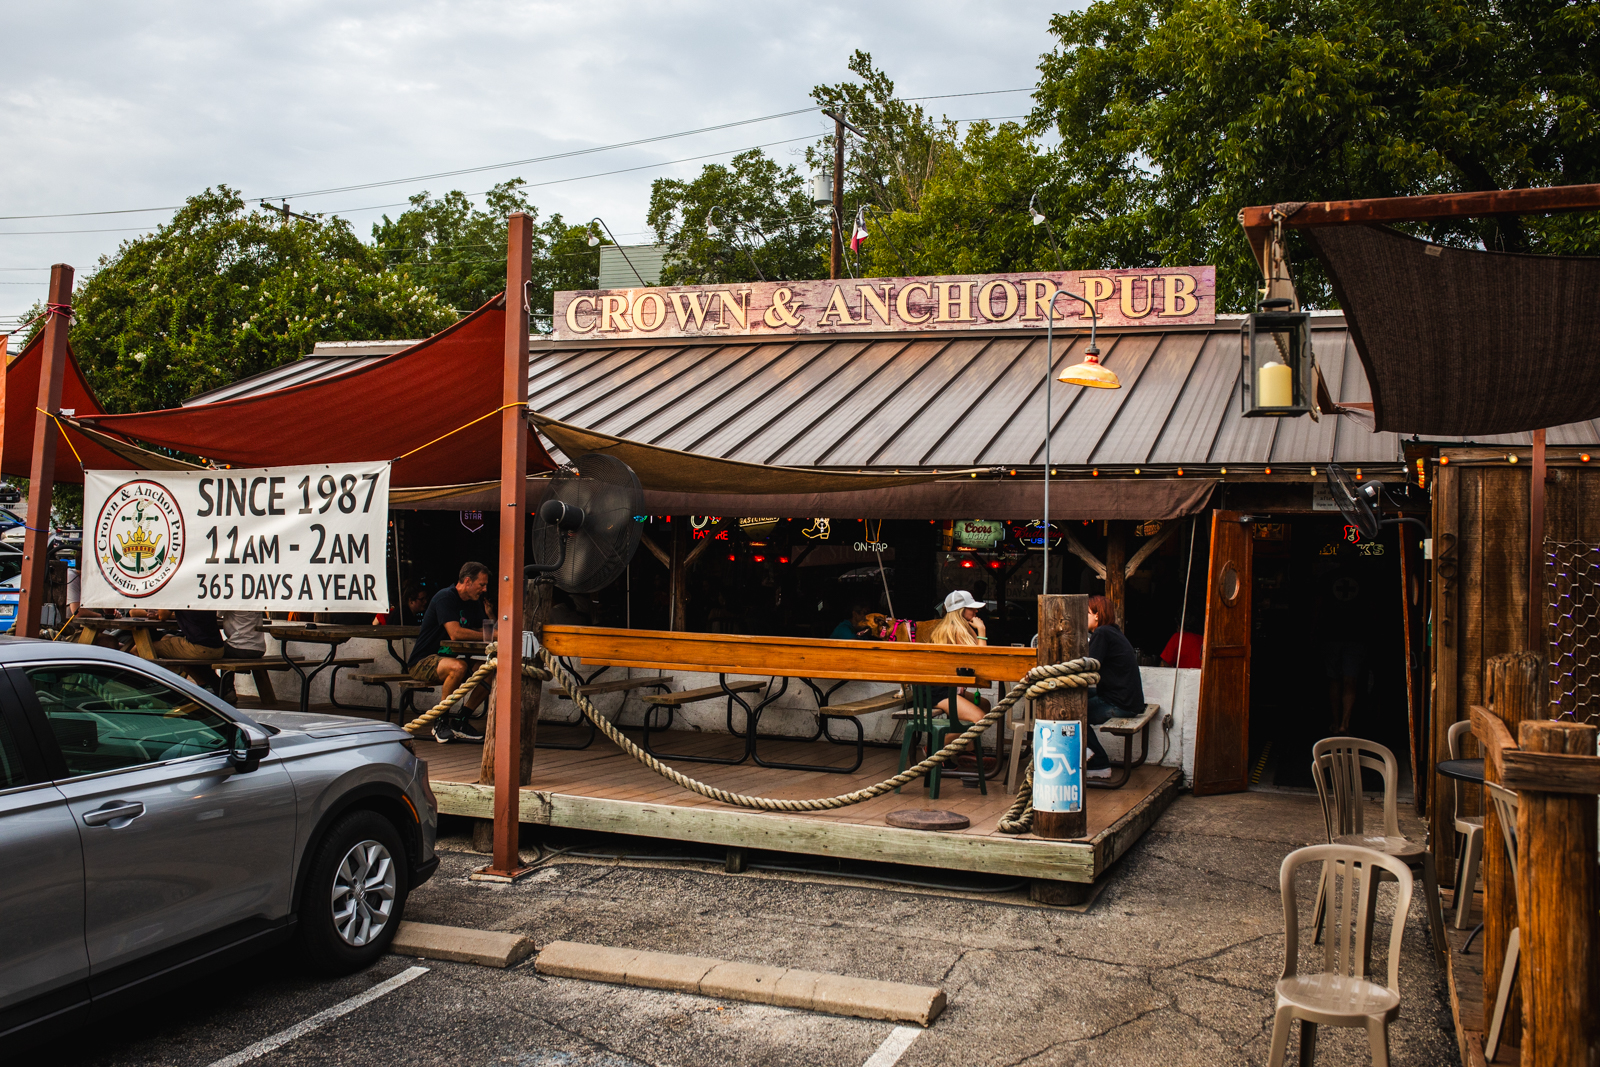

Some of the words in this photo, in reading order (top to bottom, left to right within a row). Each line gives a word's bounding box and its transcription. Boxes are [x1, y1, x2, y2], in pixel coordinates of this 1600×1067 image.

[565, 289, 752, 334] CROWN
[763, 287, 804, 328] &
[817, 278, 1064, 328] ANCHOR
[1079, 273, 1200, 320] PUB
[197, 476, 286, 517] SINCE
[297, 473, 380, 515] 1987
[98, 502, 119, 551] Crown
[121, 489, 131, 501] &
[134, 485, 174, 515] Anchor
[171, 519, 181, 552] Pub
[464, 512, 482, 520] STAR
[964, 522, 992, 533] Coors
[205, 526, 280, 565] 11AM
[309, 523, 370, 564] 2AM
[693, 528, 710, 540] FAT
[853, 541, 888, 552] ON-TAP
[107, 565, 139, 592] Austin,
[142, 566, 171, 591] Texas
[197, 573, 234, 600] 365
[242, 573, 293, 600] DAYS
[298, 573, 313, 600] A
[318, 573, 378, 600] YEAR
[1437, 533, 1457, 647] 2911
[1035, 784, 1079, 801] PARKING
